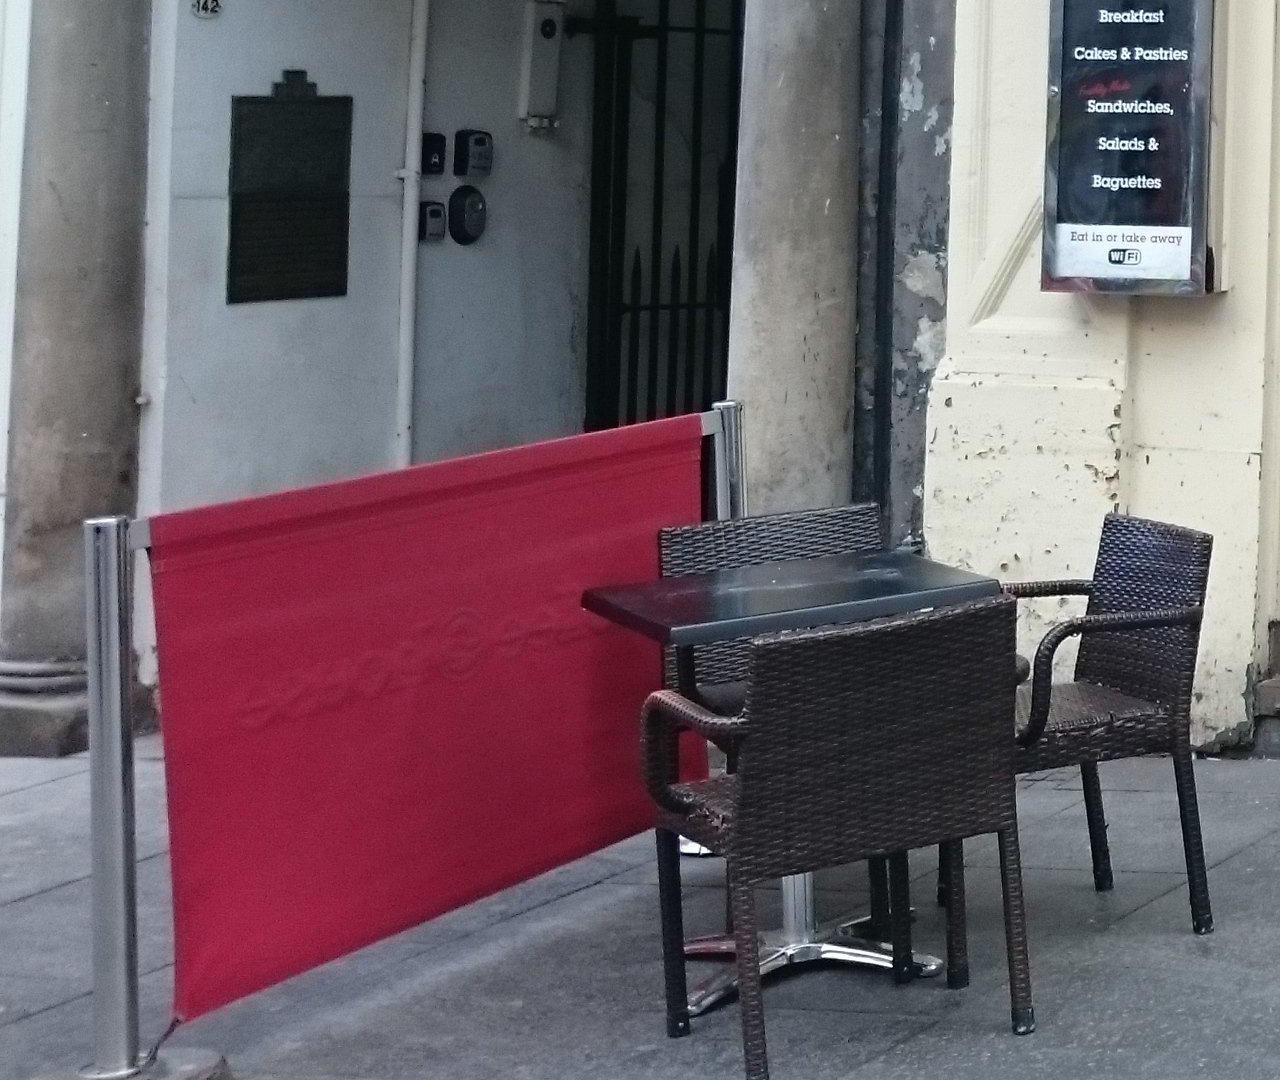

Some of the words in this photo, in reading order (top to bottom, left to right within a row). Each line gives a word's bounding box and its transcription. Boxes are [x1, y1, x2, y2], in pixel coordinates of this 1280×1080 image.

[1099, 9, 1165, 23] Breakfast
[1074, 47, 1118, 60] Cakes
[1120, 47, 1131, 60] &
[1134, 47, 1188, 60] Pastries
[1087, 99, 1174, 116] Sandwiches,
[1098, 137, 1145, 151] Salads
[1148, 137, 1159, 151] &
[1092, 174, 1162, 191] Baguettes
[1070, 231, 1088, 242] Eat
[1092, 232, 1103, 242] in
[1106, 234, 1118, 242] or
[1121, 232, 1146, 243] take
[1150, 235, 1182, 246] away
